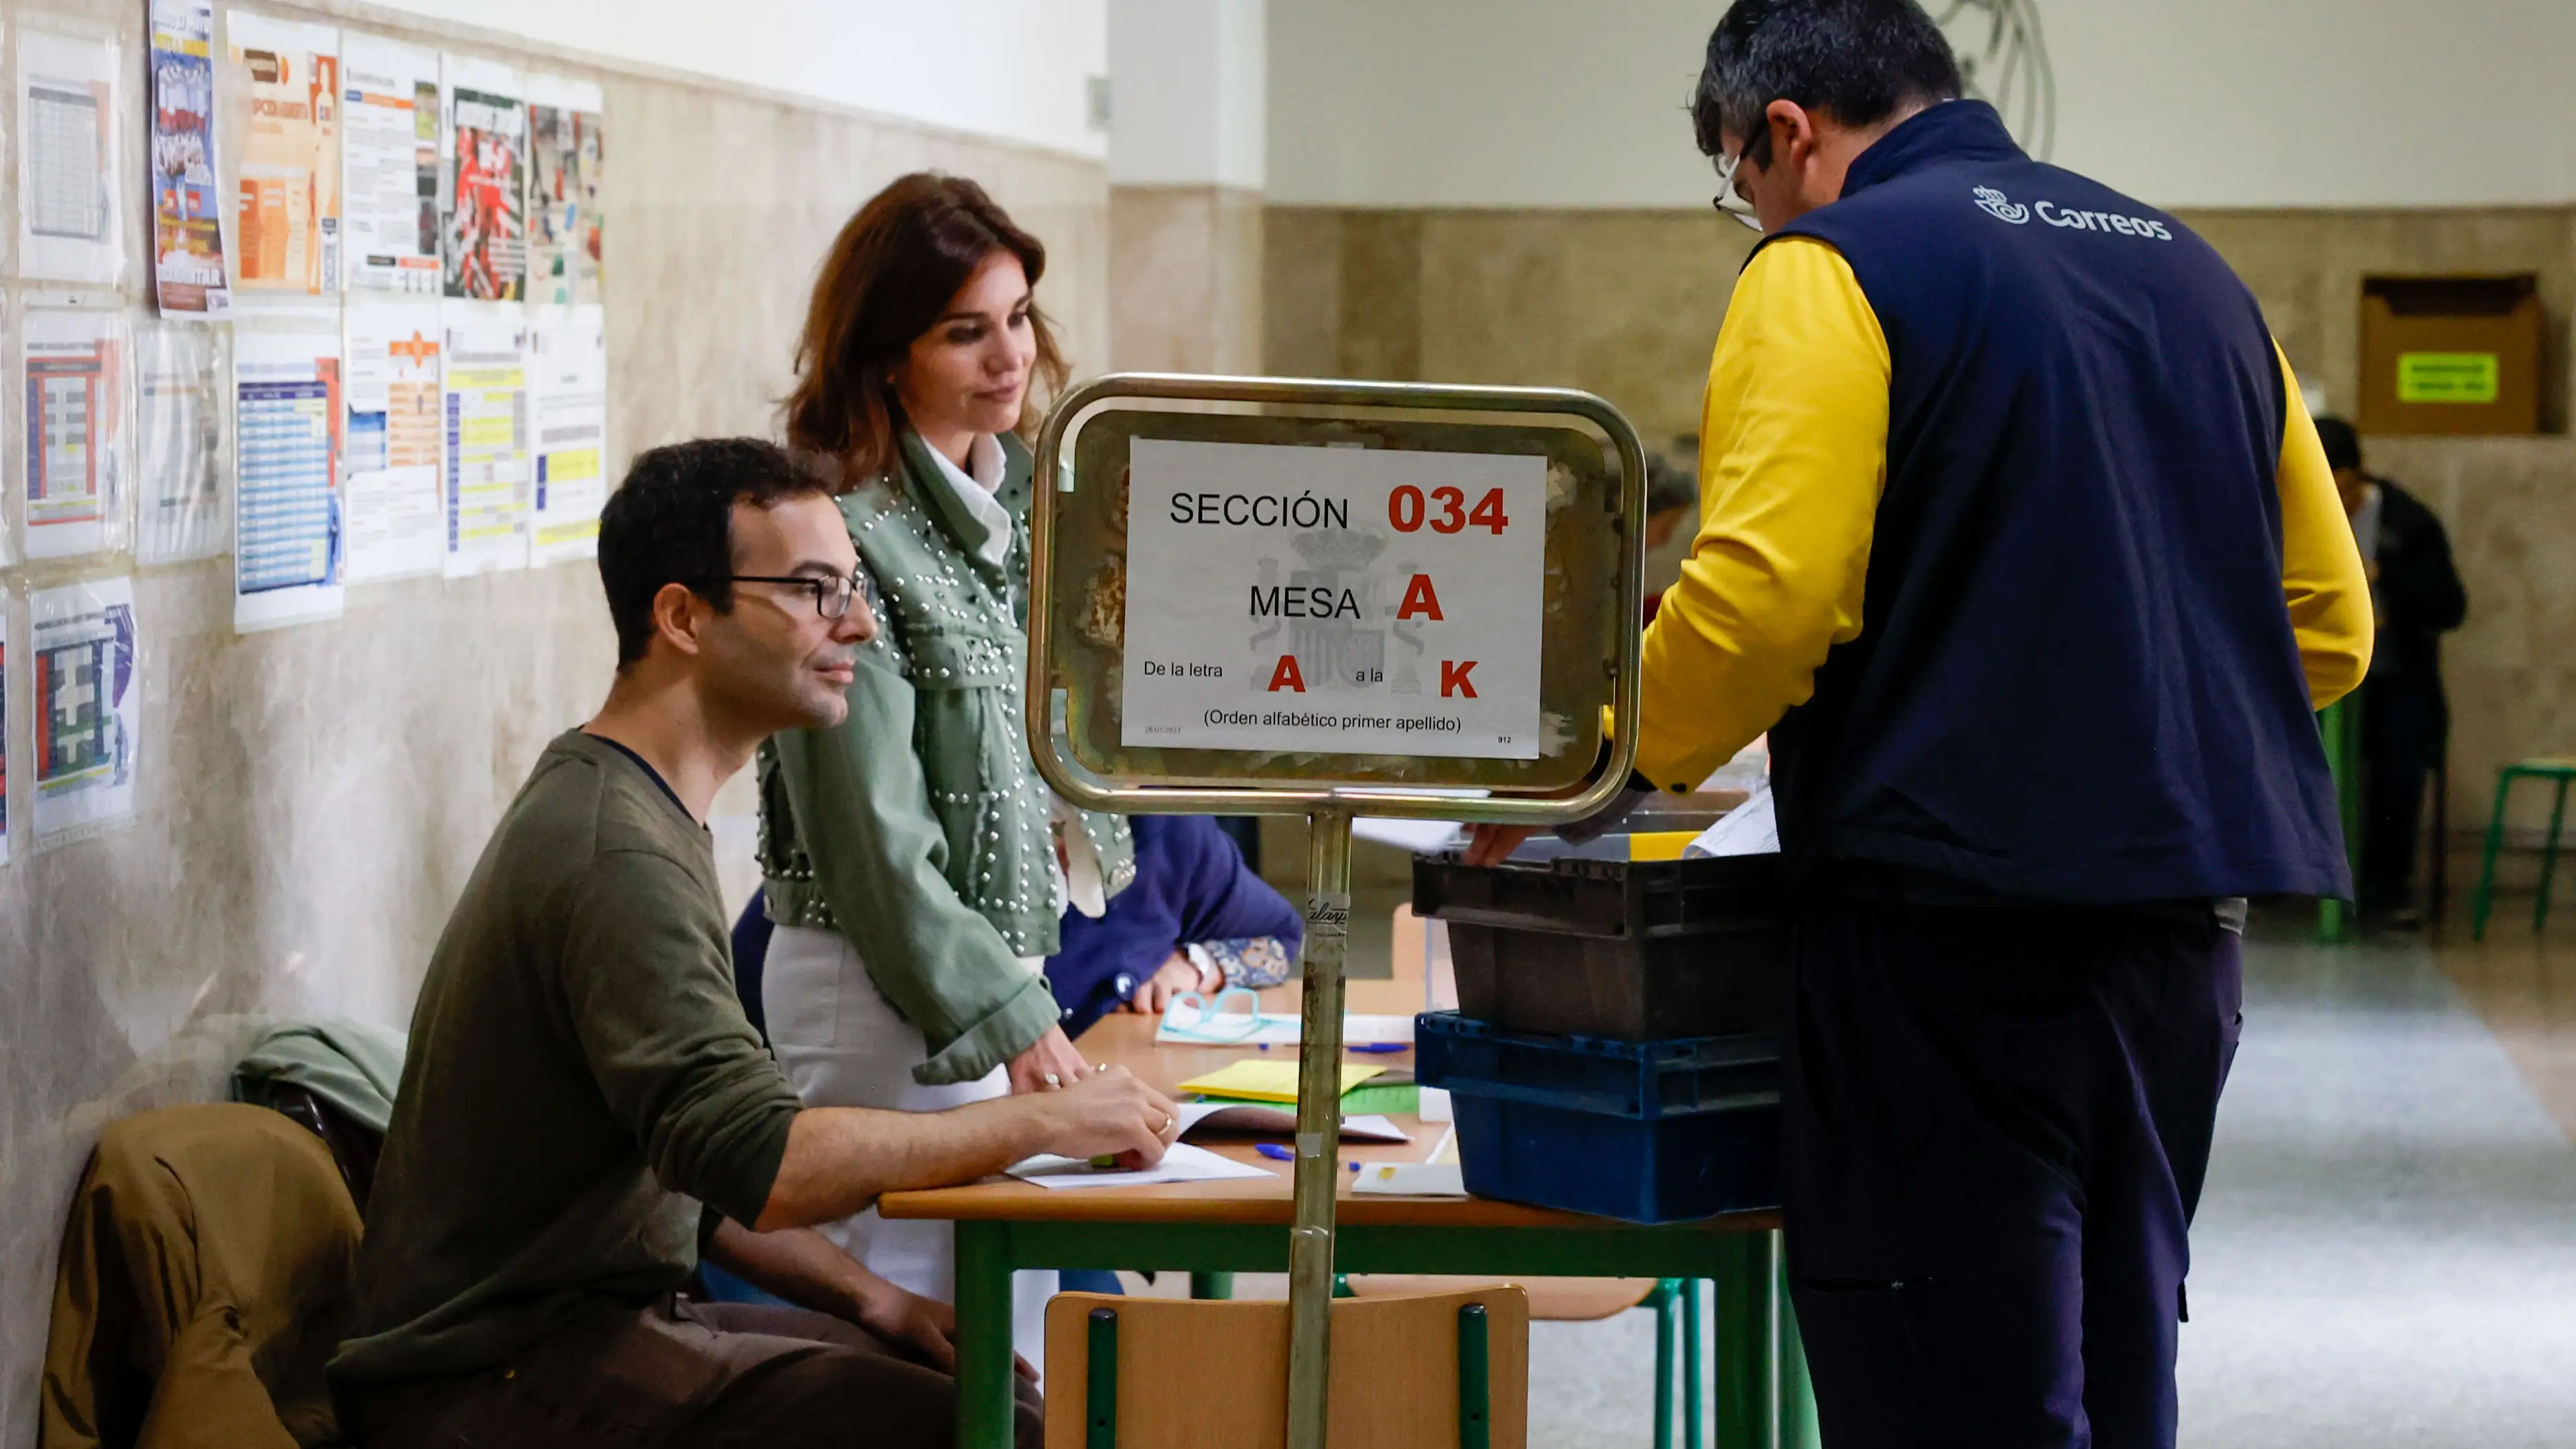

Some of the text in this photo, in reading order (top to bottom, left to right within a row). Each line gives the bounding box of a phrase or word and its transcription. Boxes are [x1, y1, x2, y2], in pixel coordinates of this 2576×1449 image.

[2034, 200, 2173, 242] Correos
[1170, 486, 1508, 535] SECCIÓN 034
[1250, 574, 1443, 621] MESA A
[1144, 655, 1478, 698] De la letra A a la K
[1204, 710, 1461, 733] (Orden alfabético primer apellido)
